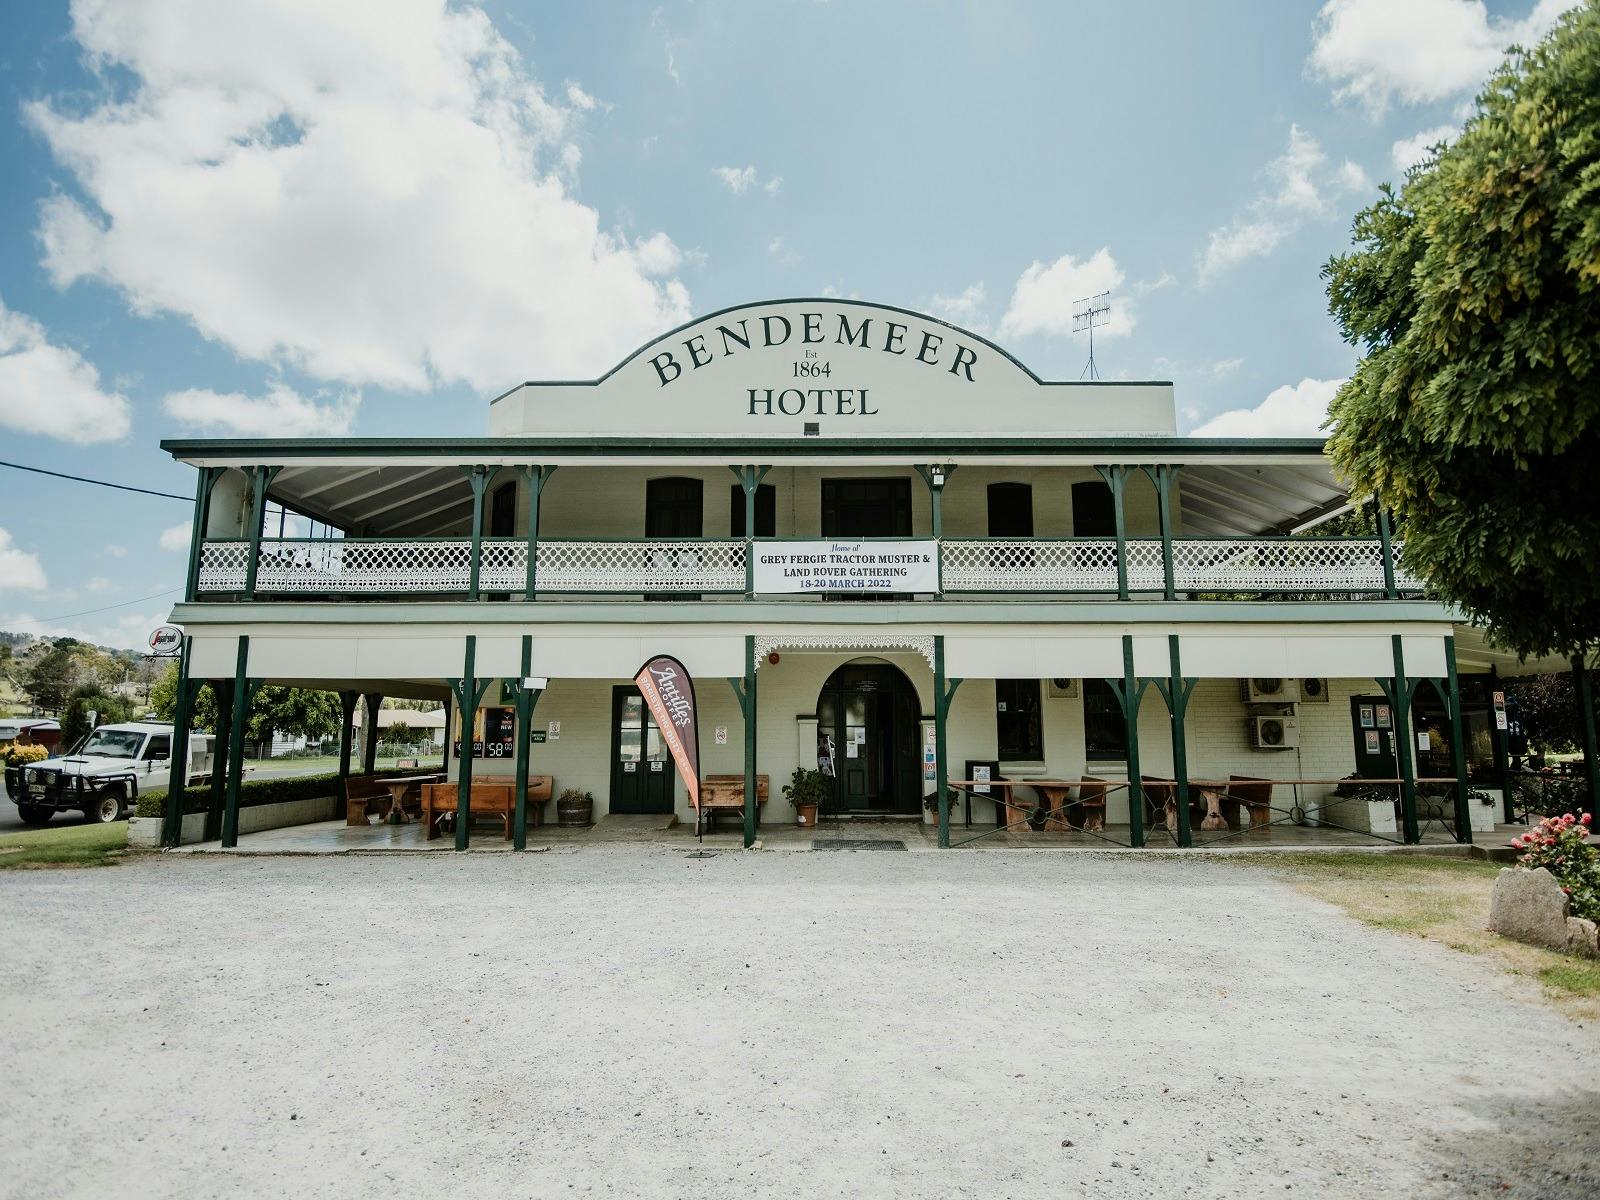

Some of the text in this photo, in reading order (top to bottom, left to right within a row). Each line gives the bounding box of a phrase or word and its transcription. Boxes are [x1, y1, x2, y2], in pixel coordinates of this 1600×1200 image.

[648, 313, 978, 387] BENDEMEER
[805, 350, 818, 358] Est
[792, 361, 831, 378] 1864
[747, 389, 879, 415] HOTEL
[760, 554, 931, 564] GREY FERGIE TRACTOR MUSTER &
[784, 567, 907, 577] LAND ROVER GATHERING
[800, 579, 891, 588] 18-20 MARCH 2022
[641, 676, 662, 713] BARISTA
[649, 667, 691, 728] Antilles
[659, 686, 681, 727] COFFEE
